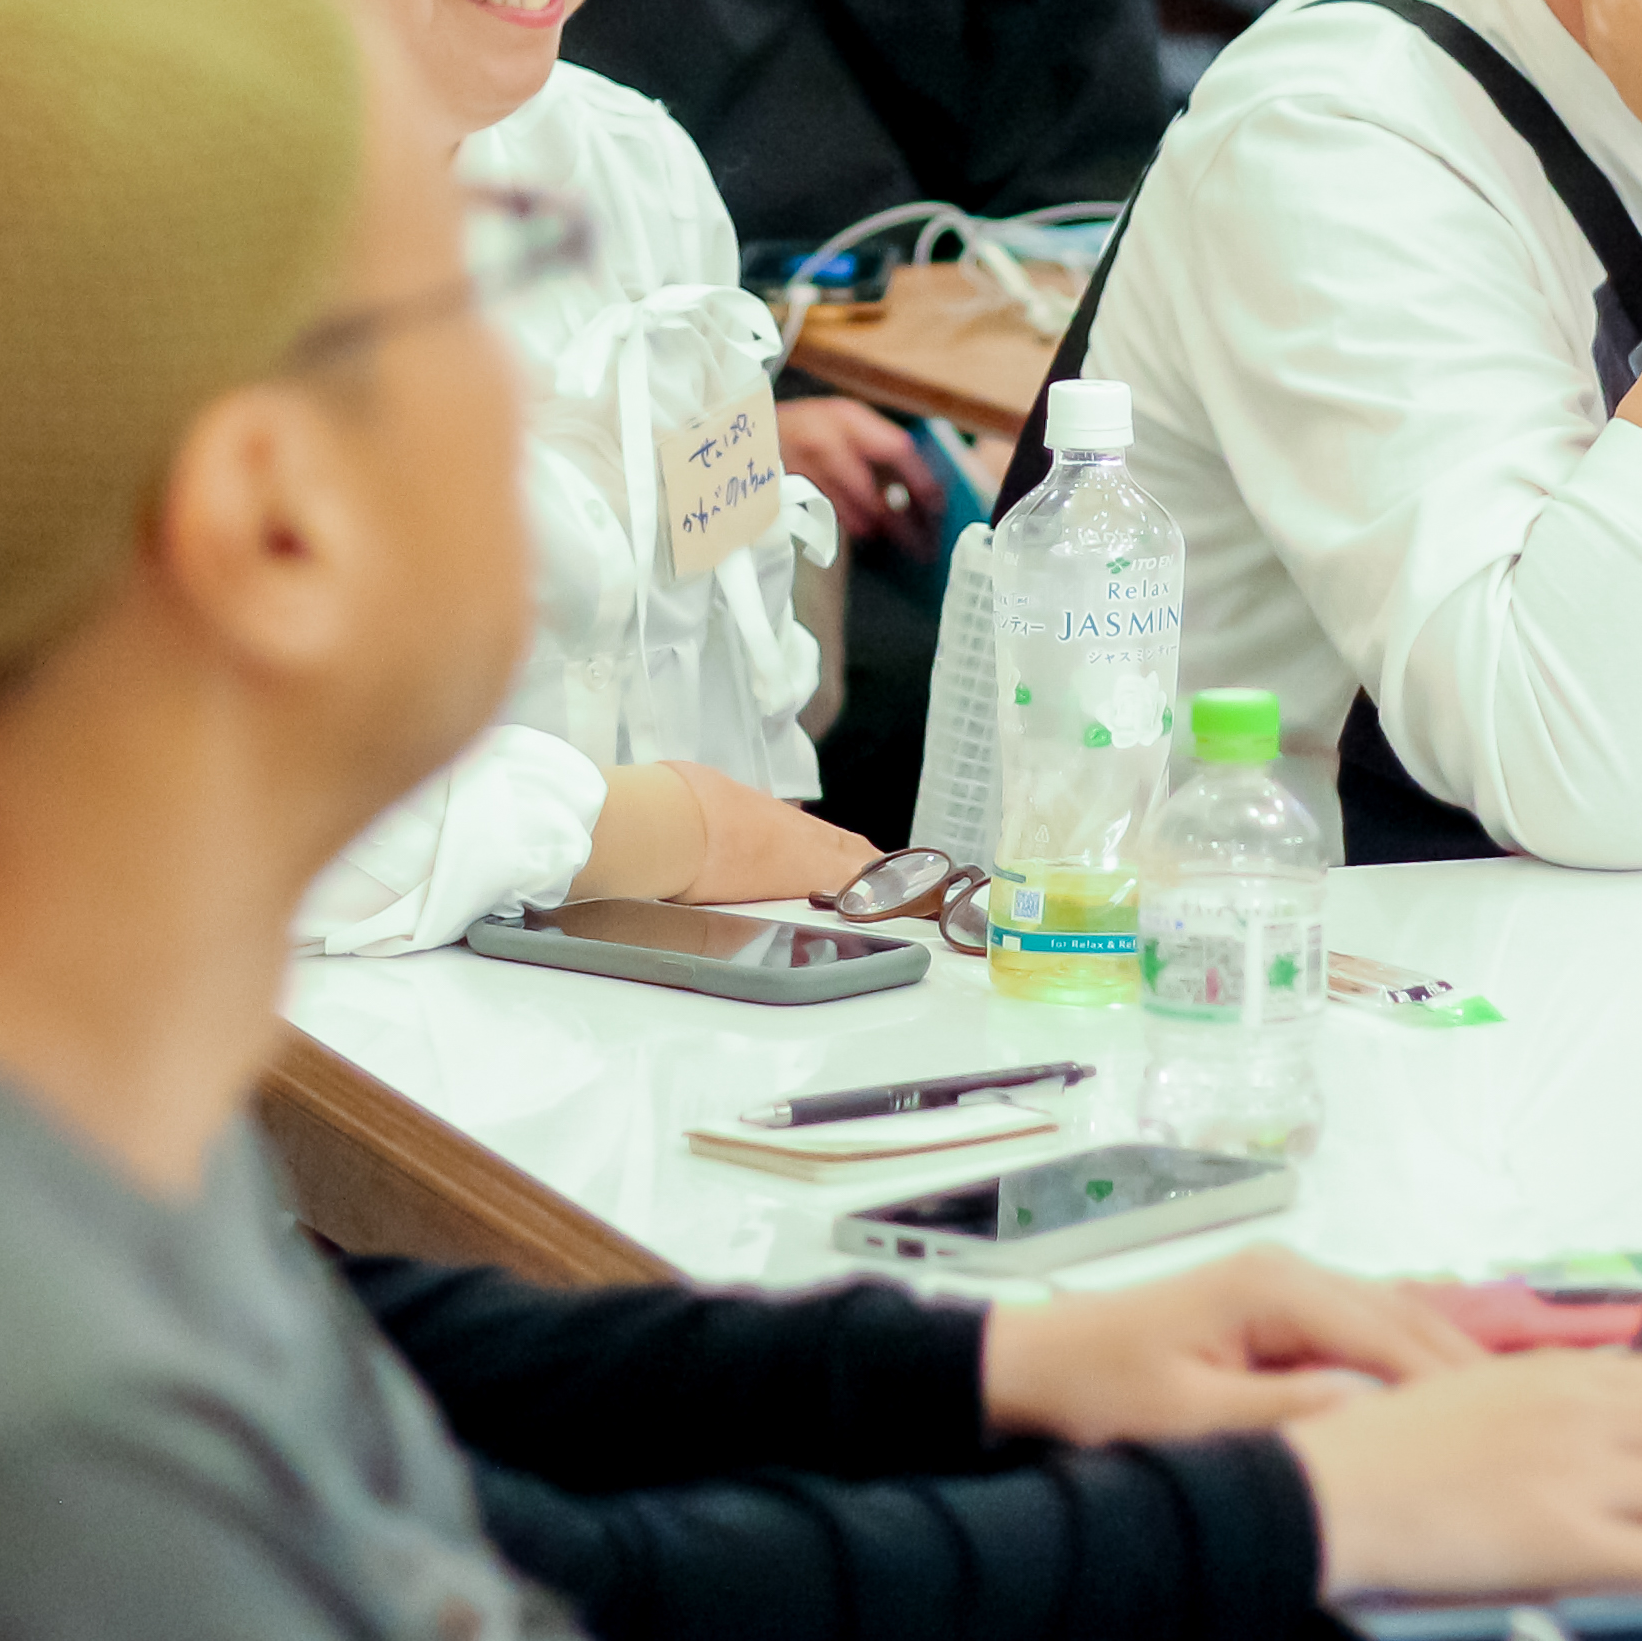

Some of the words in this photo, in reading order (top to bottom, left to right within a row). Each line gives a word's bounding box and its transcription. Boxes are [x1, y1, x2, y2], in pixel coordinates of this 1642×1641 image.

[1108, 579, 1169, 600] Relax
[1057, 602, 1181, 641] JASMIN
[1051, 939, 1066, 948] for
[1071, 939, 1103, 949] Relax
